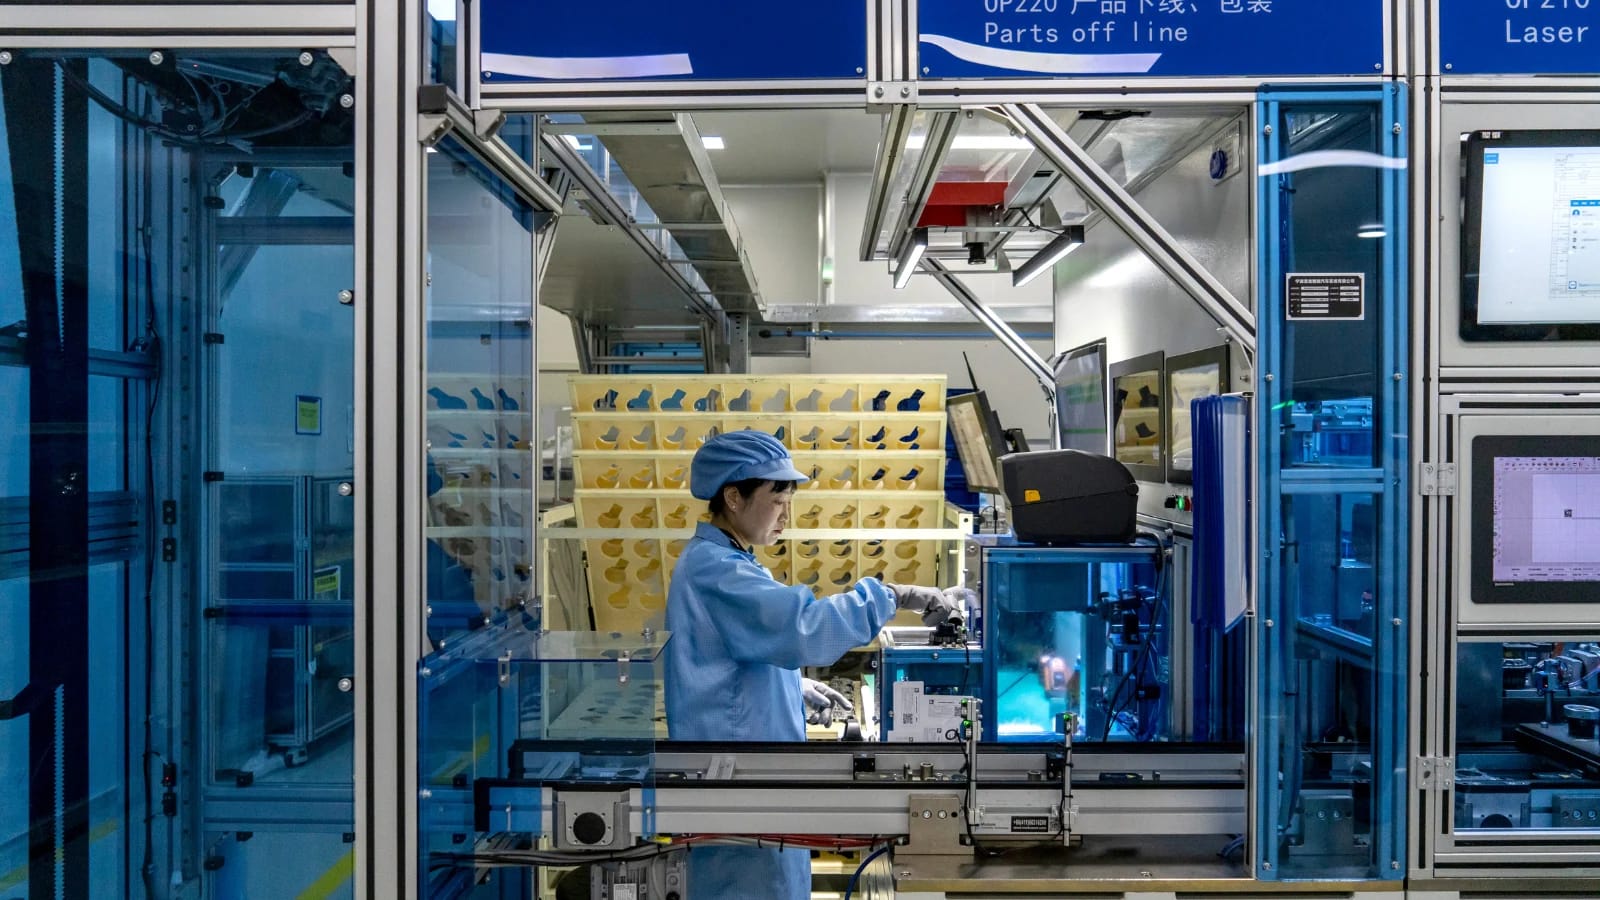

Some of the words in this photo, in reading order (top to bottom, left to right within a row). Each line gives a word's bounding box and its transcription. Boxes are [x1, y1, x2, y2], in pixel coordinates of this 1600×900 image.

[985, 22, 1058, 43] Parts
[1072, 21, 1116, 42] off
[1133, 21, 1188, 42] line
[1506, 19, 1589, 43] Laser
